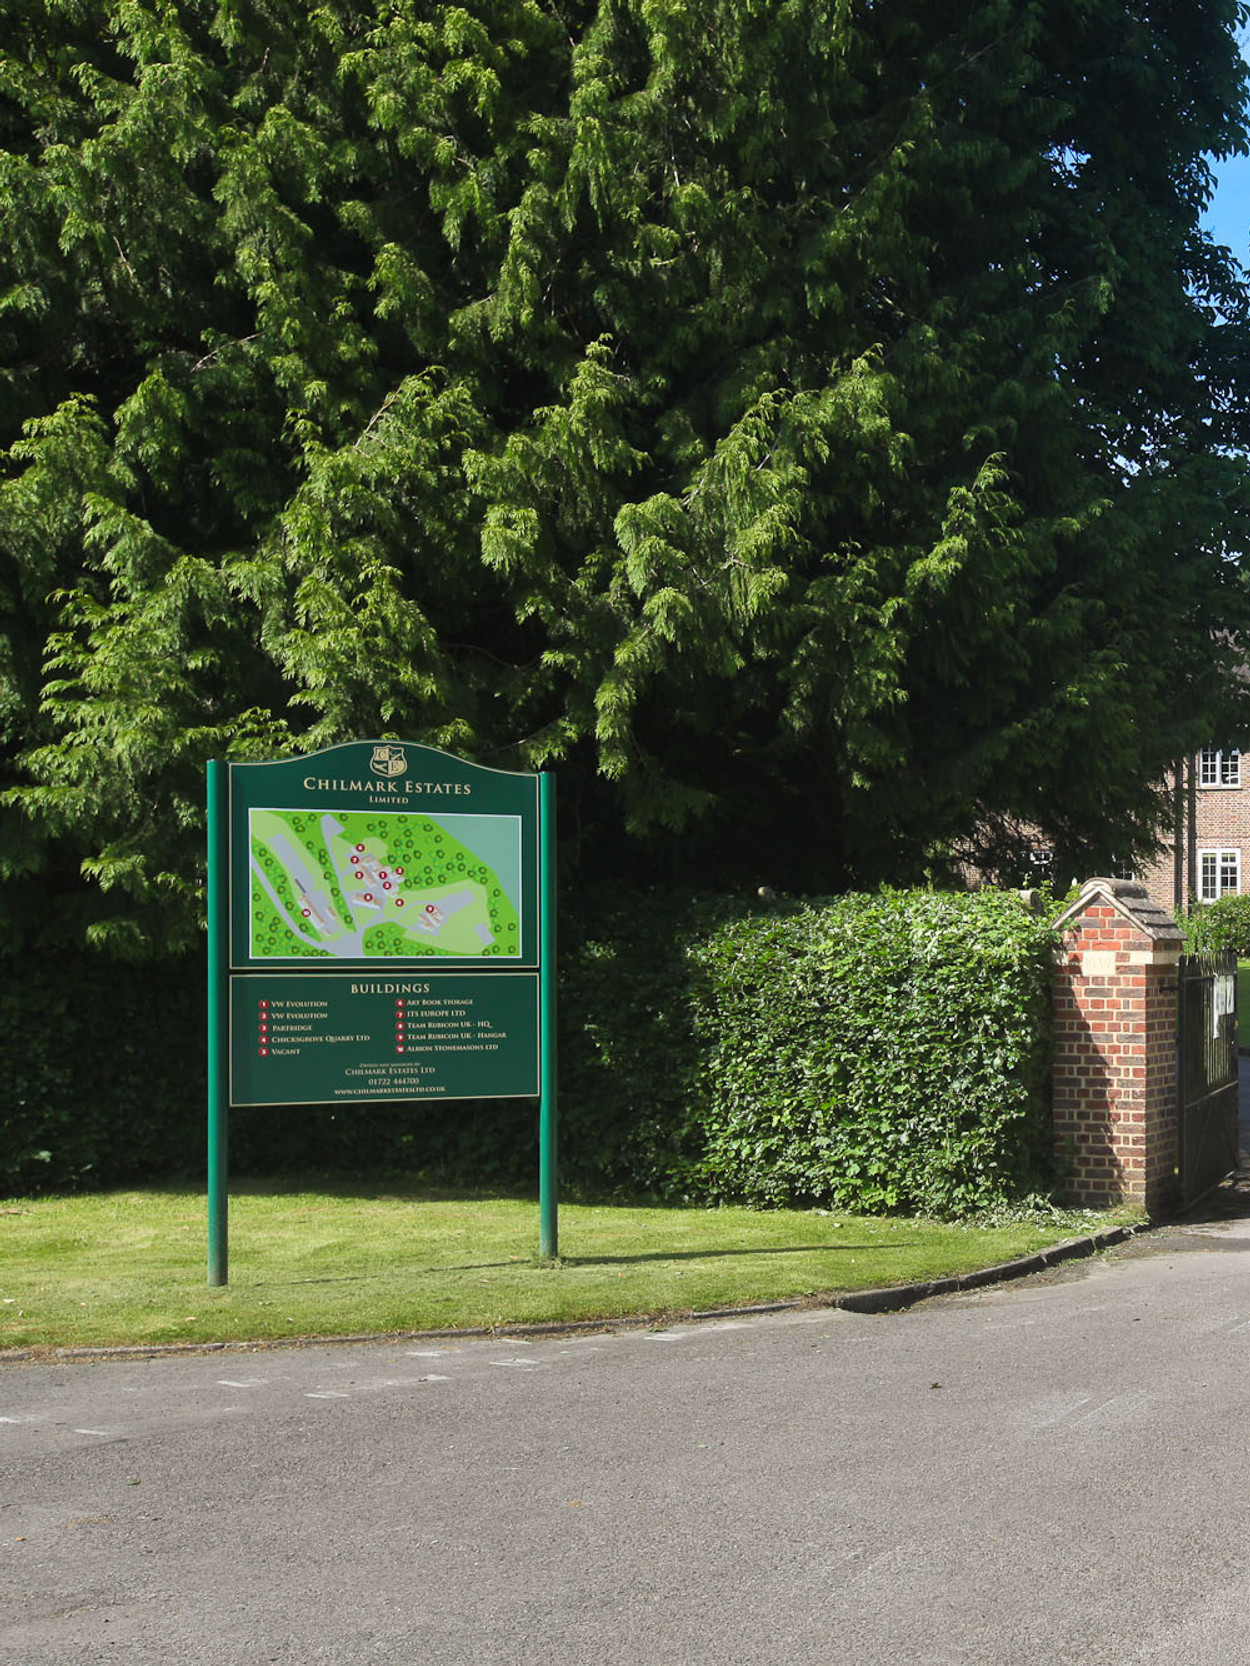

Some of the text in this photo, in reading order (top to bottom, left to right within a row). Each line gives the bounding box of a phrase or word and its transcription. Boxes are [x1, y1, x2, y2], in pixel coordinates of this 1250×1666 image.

[378, 750, 386, 760] C
[391, 762, 399, 771] E
[303, 777, 471, 795] CHILMARK ESTATES
[369, 795, 409, 804] LIMITED
[351, 983, 430, 994] BUILDINGS
[325, 1035, 355, 1043] QUARRY
[345, 1068, 387, 1076] CHILMARK
[389, 1067, 418, 1075] ESTATES
